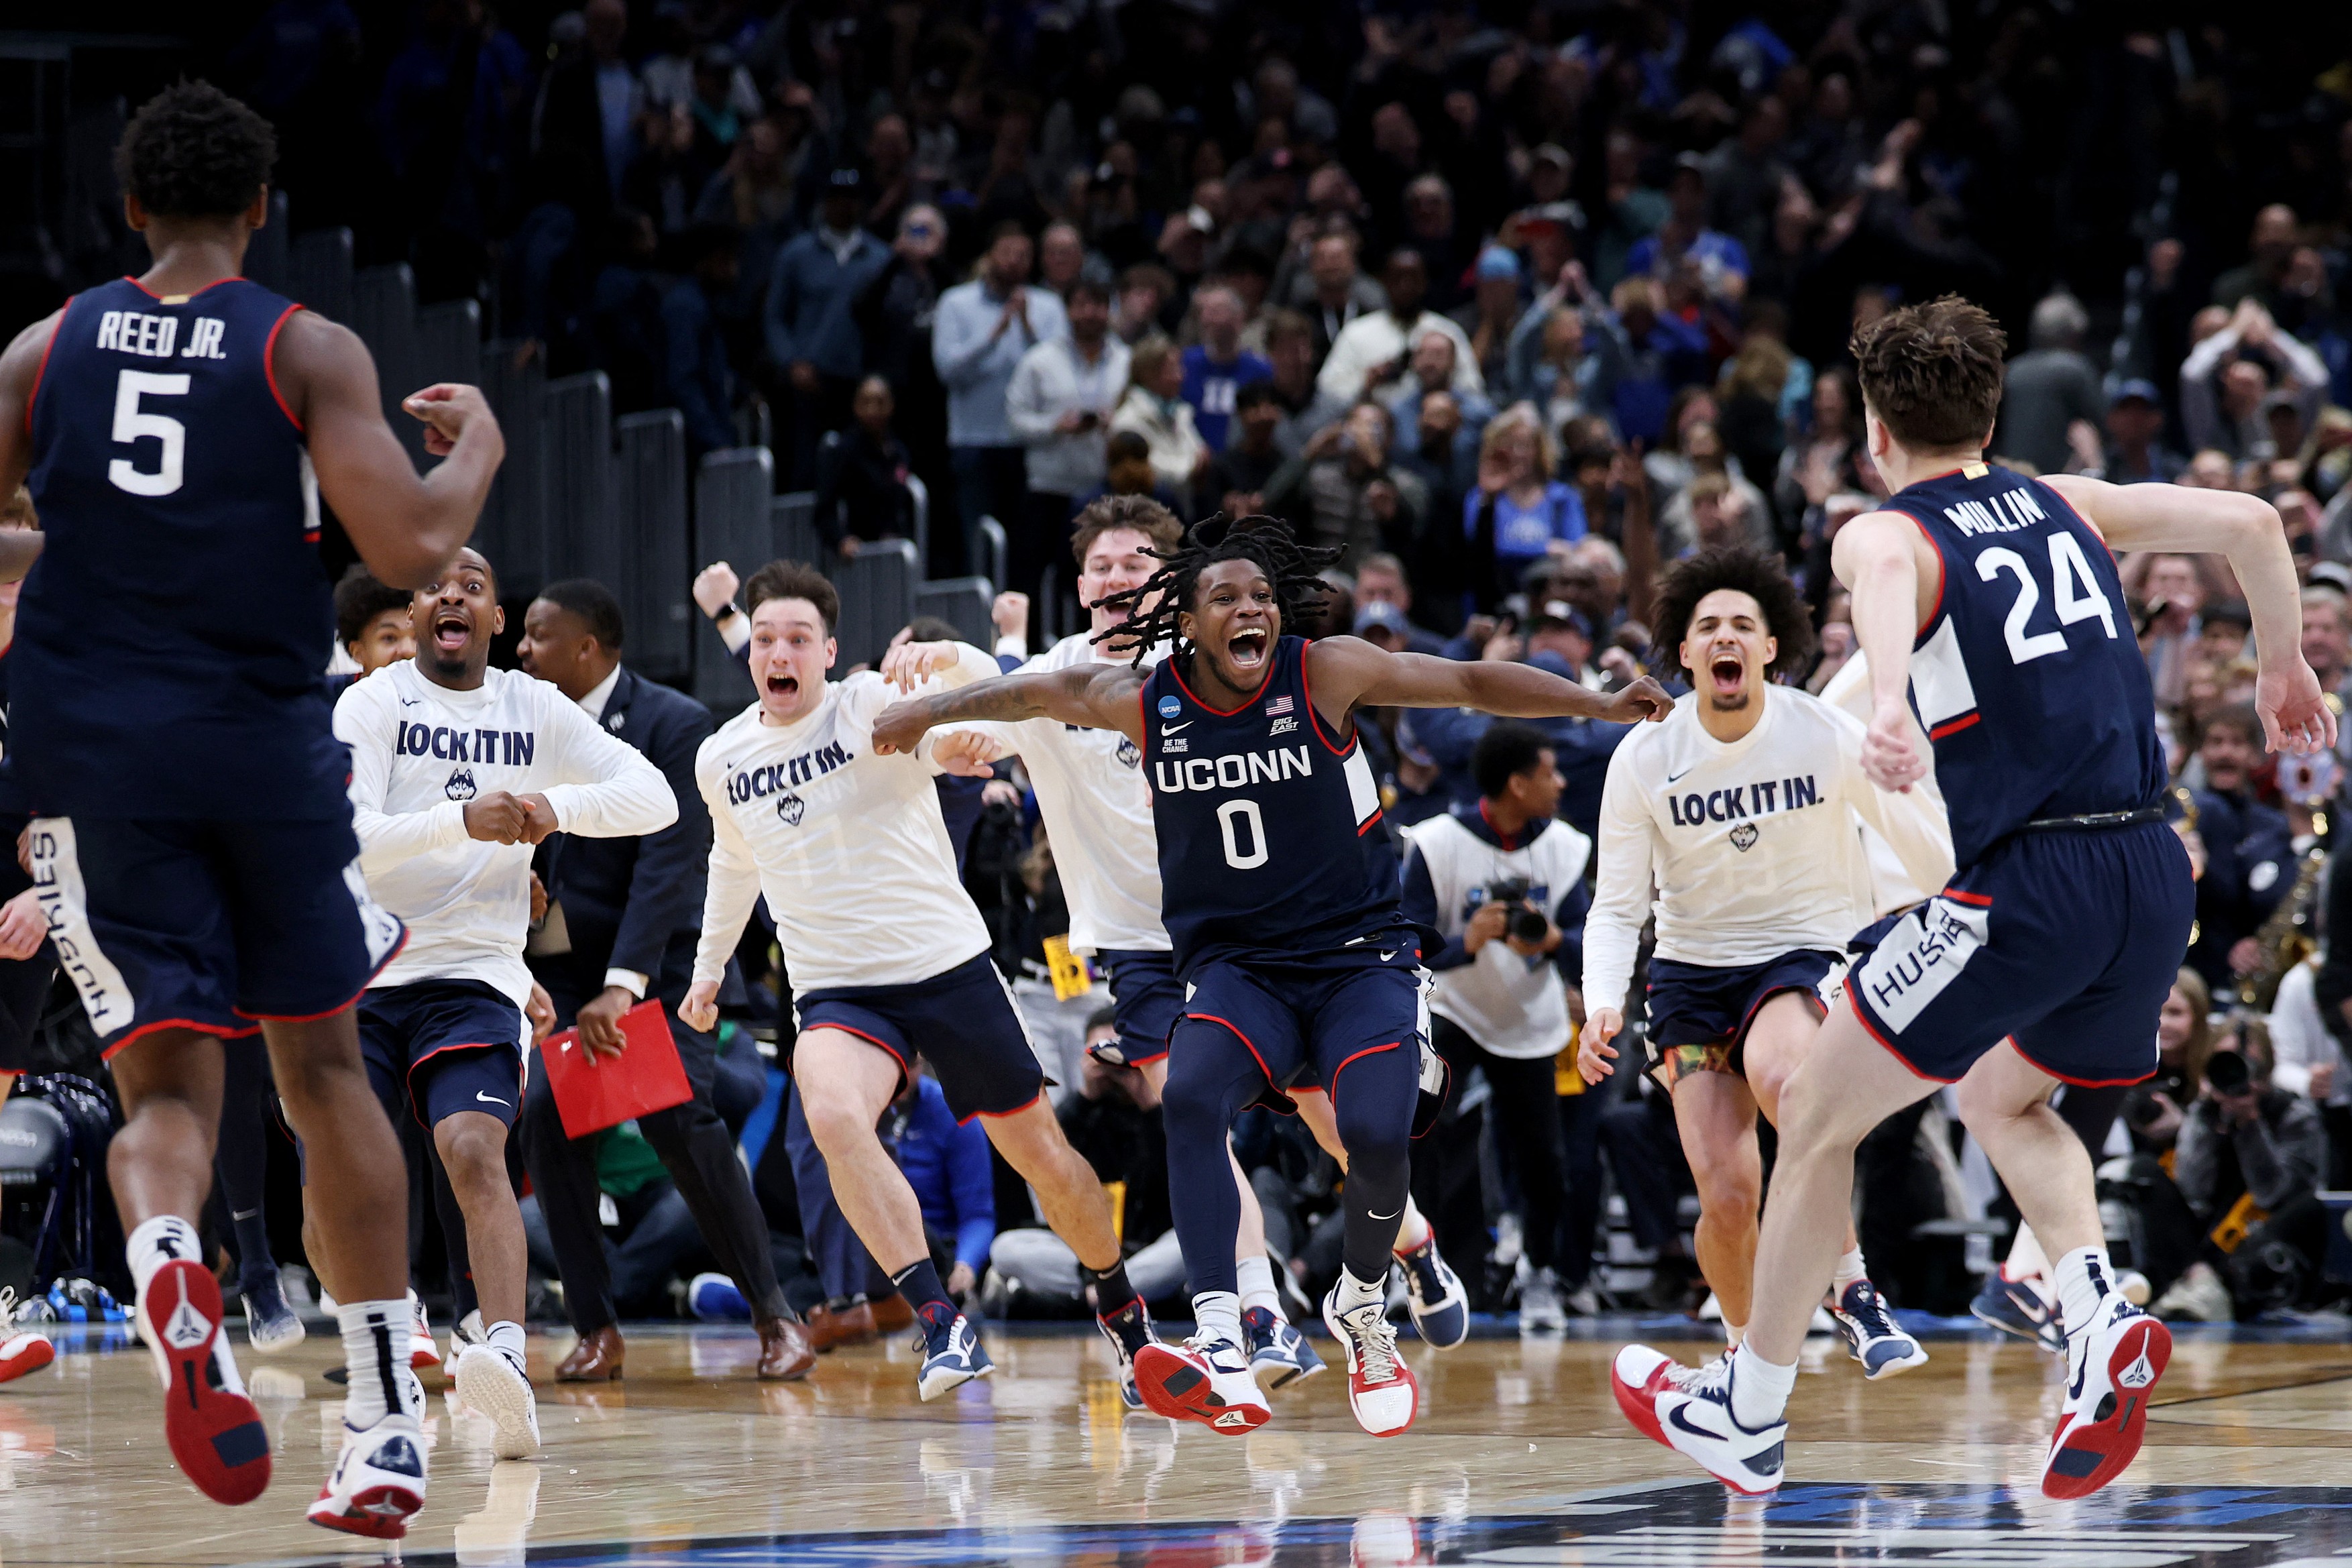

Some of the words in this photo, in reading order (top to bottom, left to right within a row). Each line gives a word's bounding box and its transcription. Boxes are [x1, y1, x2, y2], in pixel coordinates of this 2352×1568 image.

[97, 312, 178, 357] REED
[181, 317, 227, 359] JR.
[108, 370, 191, 496] 5
[1943, 487, 2046, 537] MULLIN
[1974, 531, 2118, 665] 24
[1162, 705, 1180, 714] NCAA
[1270, 721, 1299, 733] EAST
[1274, 716, 1292, 726] BIG
[396, 720, 469, 762] LOCK
[473, 729, 499, 763] IT
[1162, 745, 1188, 753] CHANGE
[727, 763, 787, 805] LOCK
[789, 752, 812, 787] IT
[815, 739, 854, 774] IN.
[1156, 744, 1312, 793] UCONN
[1669, 787, 1747, 827] LOCK
[1750, 781, 1778, 814] IT
[1783, 775, 1824, 810] IN.
[1217, 799, 1269, 869] 0
[33, 832, 110, 1018] HUSKIES
